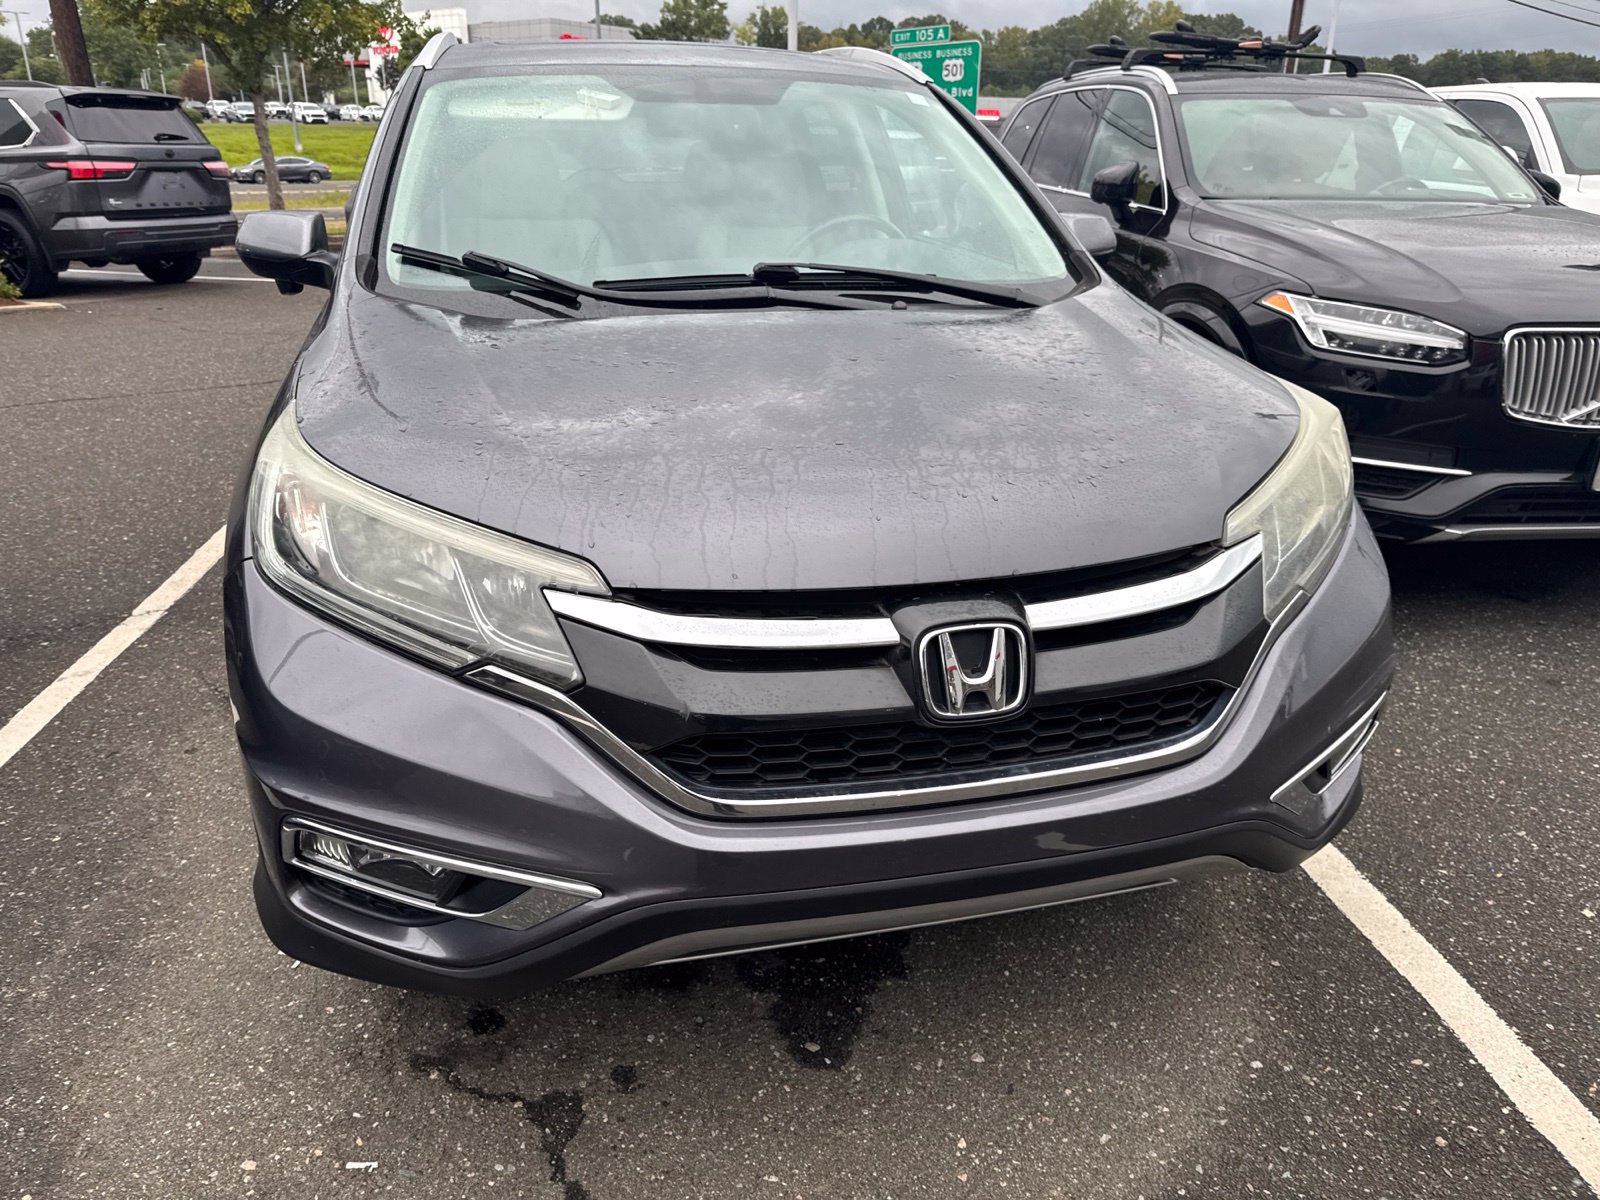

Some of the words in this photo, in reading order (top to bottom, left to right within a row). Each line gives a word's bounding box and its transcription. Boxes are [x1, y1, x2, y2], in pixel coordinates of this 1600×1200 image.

[895, 32, 911, 42] EXIT
[915, 28, 934, 41] 105
[937, 29, 945, 39] A
[898, 50, 932, 60] BUSINESS
[936, 47, 972, 58] BUSINESS
[944, 63, 963, 77] 501
[951, 87, 973, 97] Blvd
